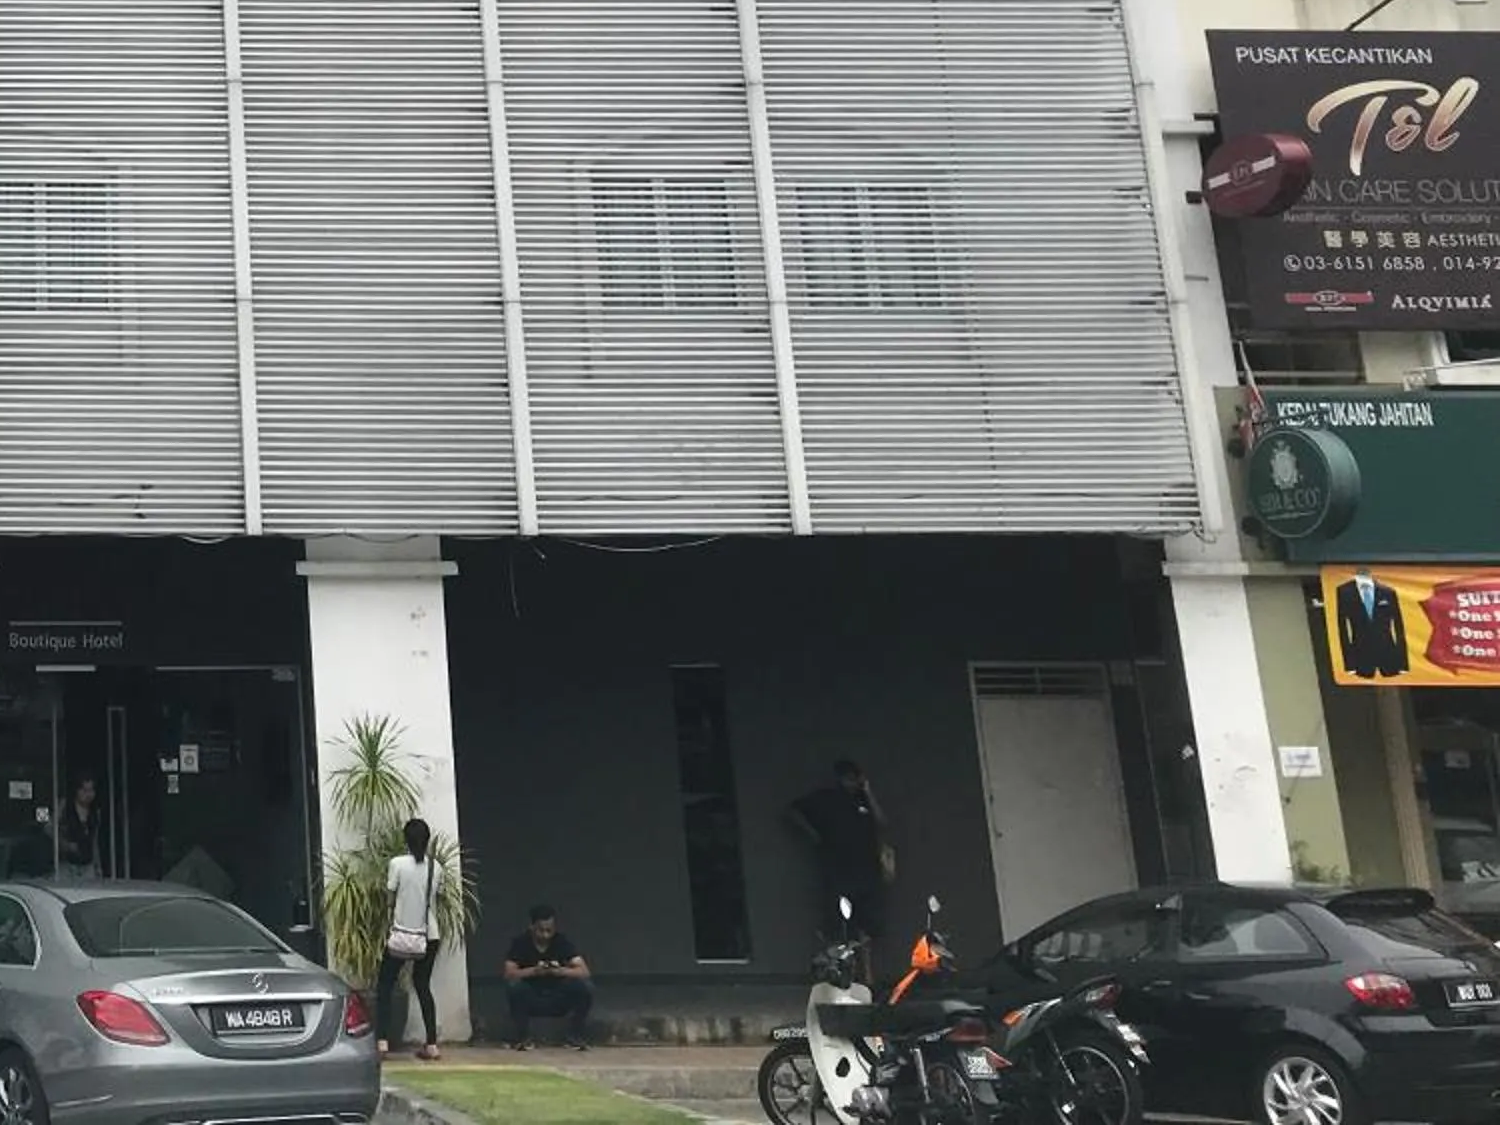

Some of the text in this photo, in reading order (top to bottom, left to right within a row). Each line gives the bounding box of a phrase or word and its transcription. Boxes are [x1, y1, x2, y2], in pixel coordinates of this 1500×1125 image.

[1235, 46, 1433, 65] PUSAT KECANTIKAN
[1338, 179, 1411, 203] CARE
[1303, 255, 1374, 271] 03-6151
[1382, 255, 1426, 271] 6858
[1379, 403, 1435, 426] JAHITAN
[8, 632, 123, 653] Boutique Hotel
